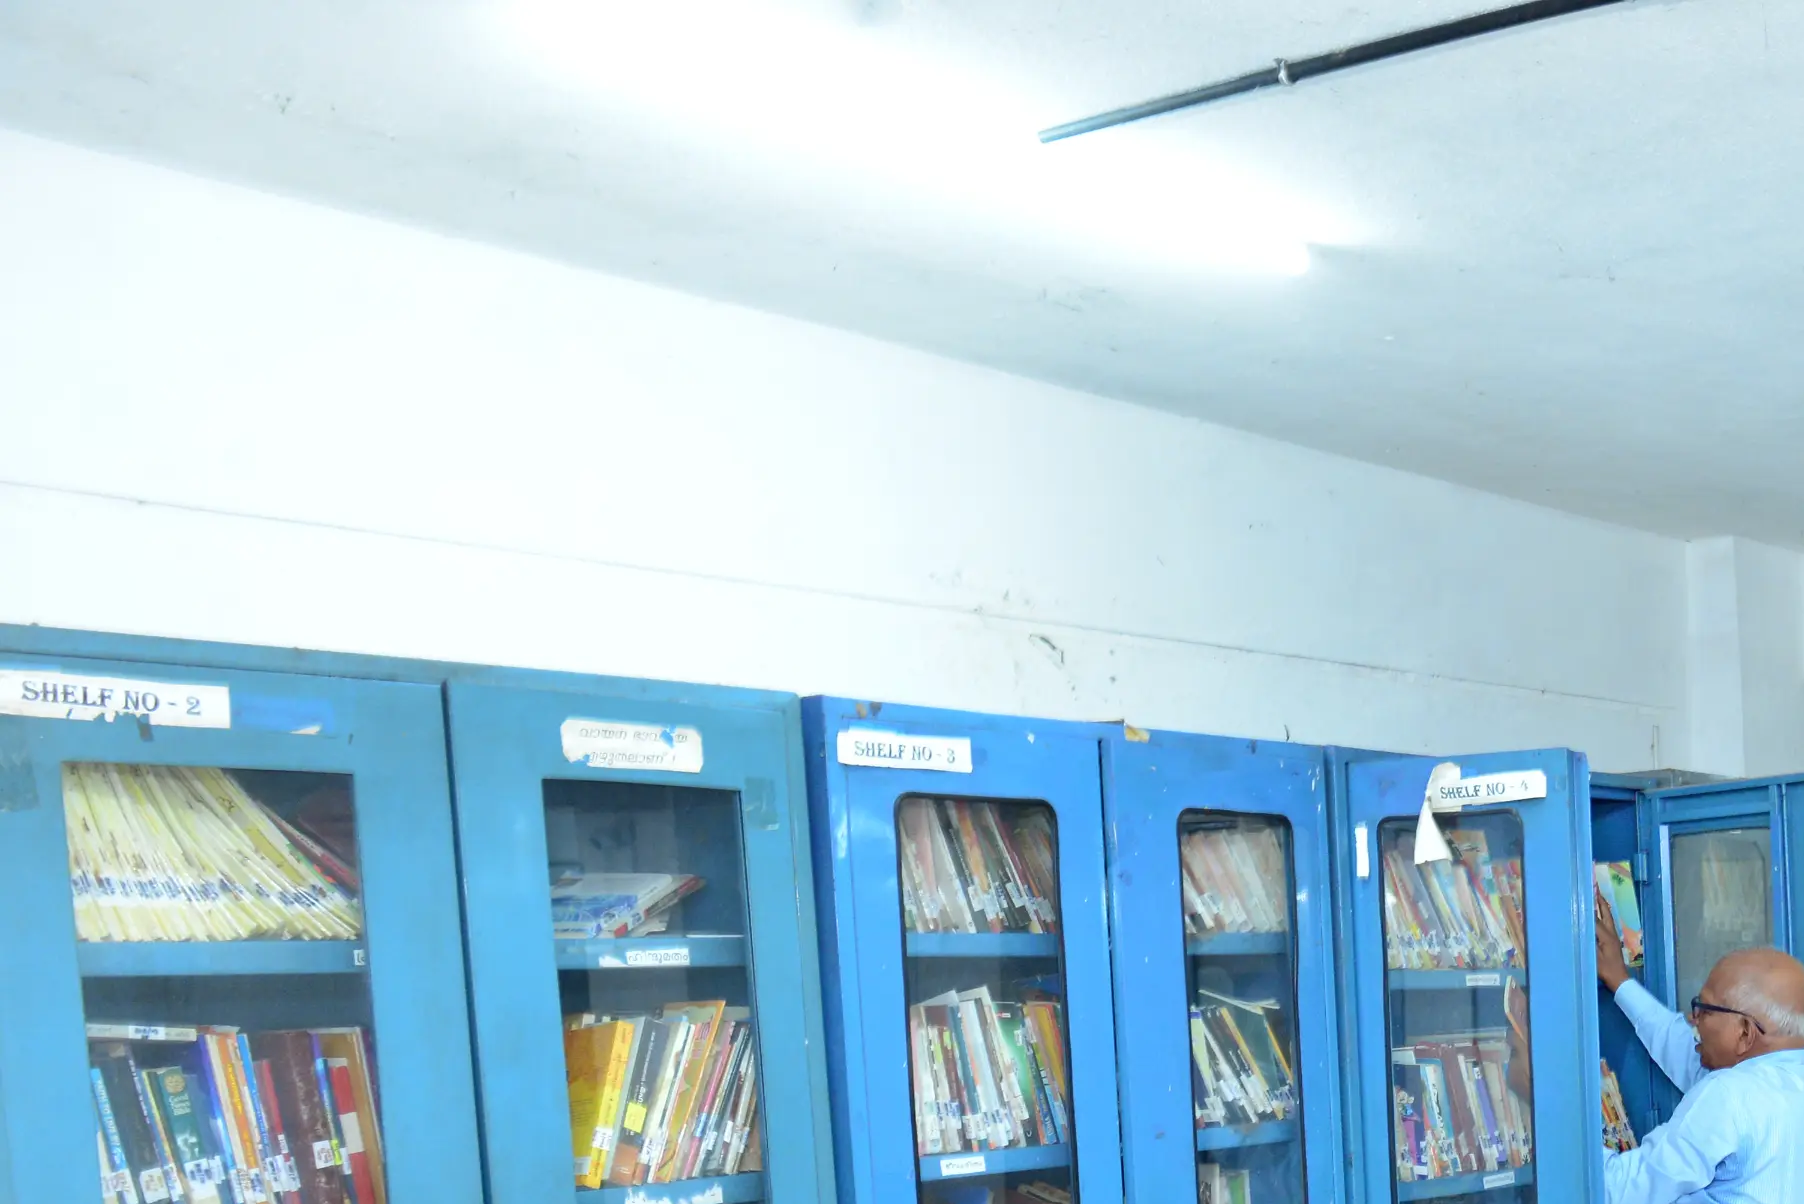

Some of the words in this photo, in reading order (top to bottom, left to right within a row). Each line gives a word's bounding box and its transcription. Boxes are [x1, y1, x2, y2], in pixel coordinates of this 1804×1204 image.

[21, 680, 114, 707] SHELF
[124, 690, 160, 712] NO
[186, 696, 202, 716] 2
[854, 740, 906, 760] SHELF
[911, 745, 932, 762] NO
[946, 748, 956, 764] 3
[1440, 784, 1481, 799] SHELF
[1486, 782, 1505, 796] NO
[1520, 780, 1529, 792] 4
